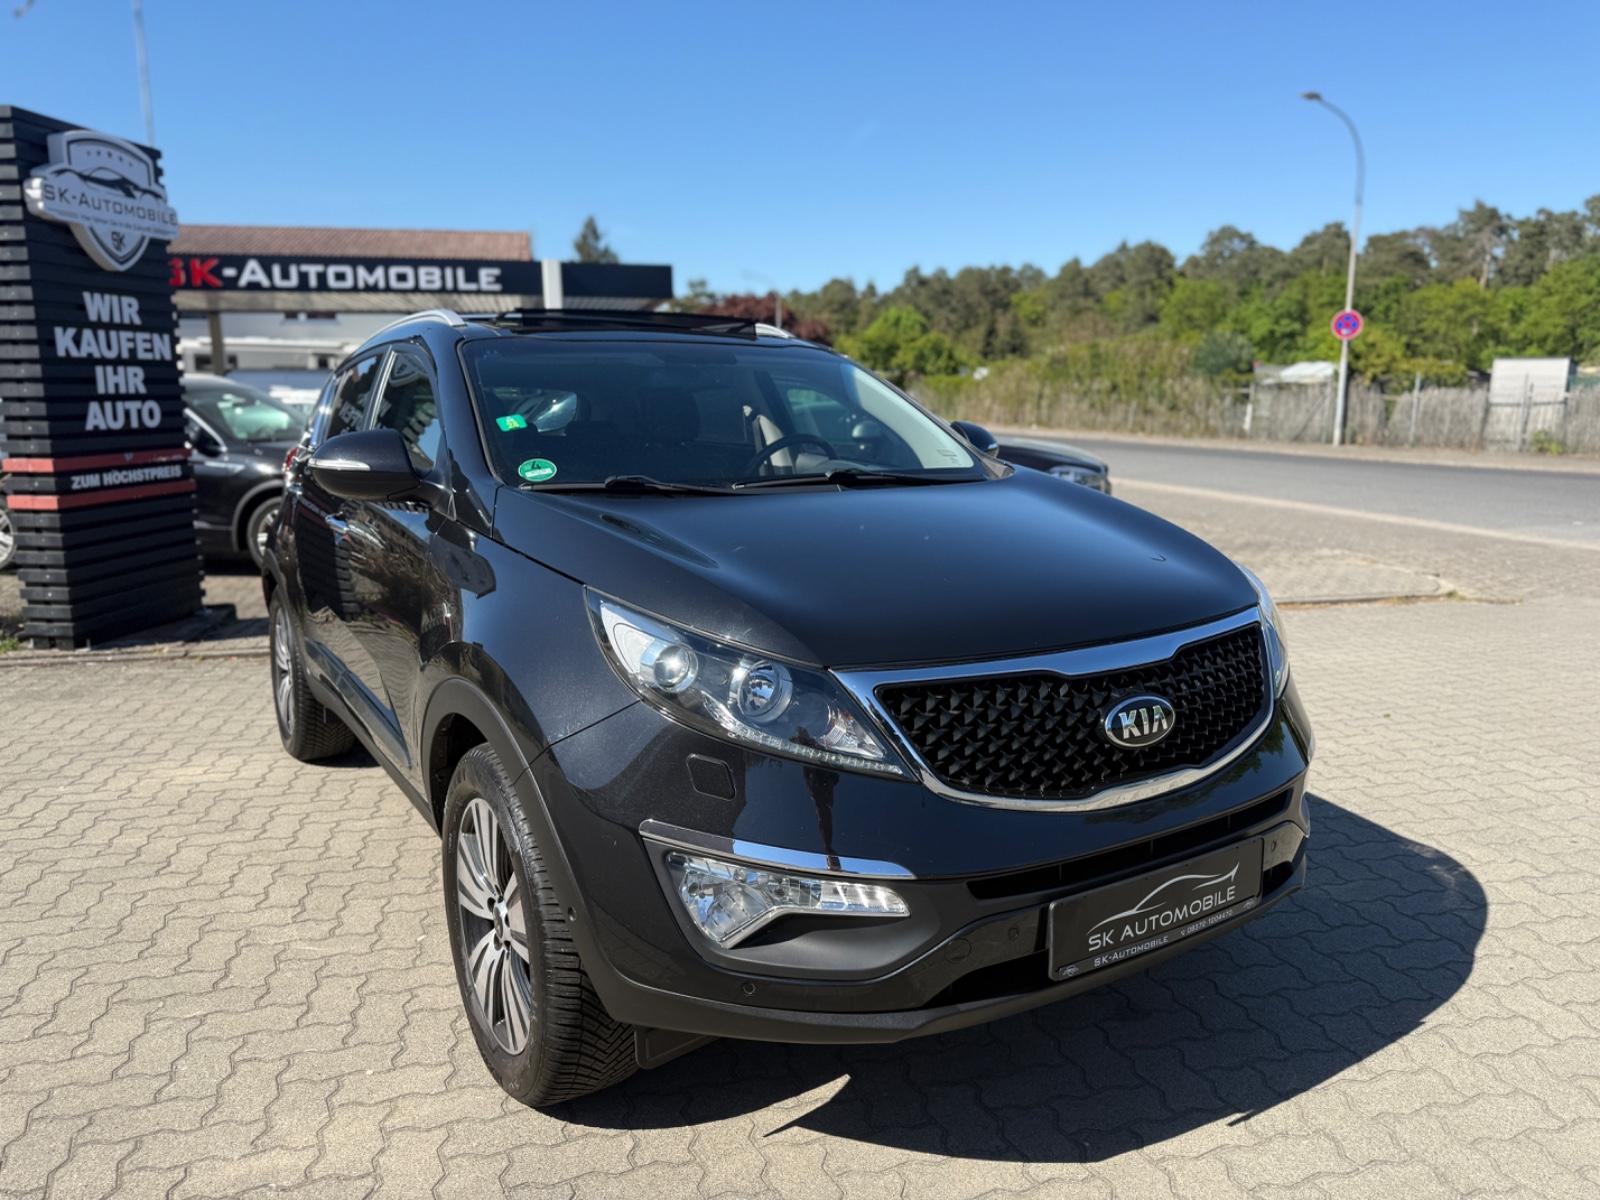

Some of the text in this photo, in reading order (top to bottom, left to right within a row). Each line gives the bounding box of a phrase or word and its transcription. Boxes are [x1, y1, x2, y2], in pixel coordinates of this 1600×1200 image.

[43, 183, 178, 226] SK-AUTOMOBILE
[168, 257, 503, 292] SK-AUTOMOBILE
[82, 291, 142, 326] WIR
[54, 326, 173, 361] KAUFEN
[94, 365, 147, 395] IHR
[85, 400, 162, 431] AUTO
[71, 474, 101, 490] ZUM
[1118, 705, 1168, 740] KIA
[1088, 885, 1236, 952] SK AUTOMOBILE
[1093, 935, 1169, 967] SK-AUTOMOBILE
